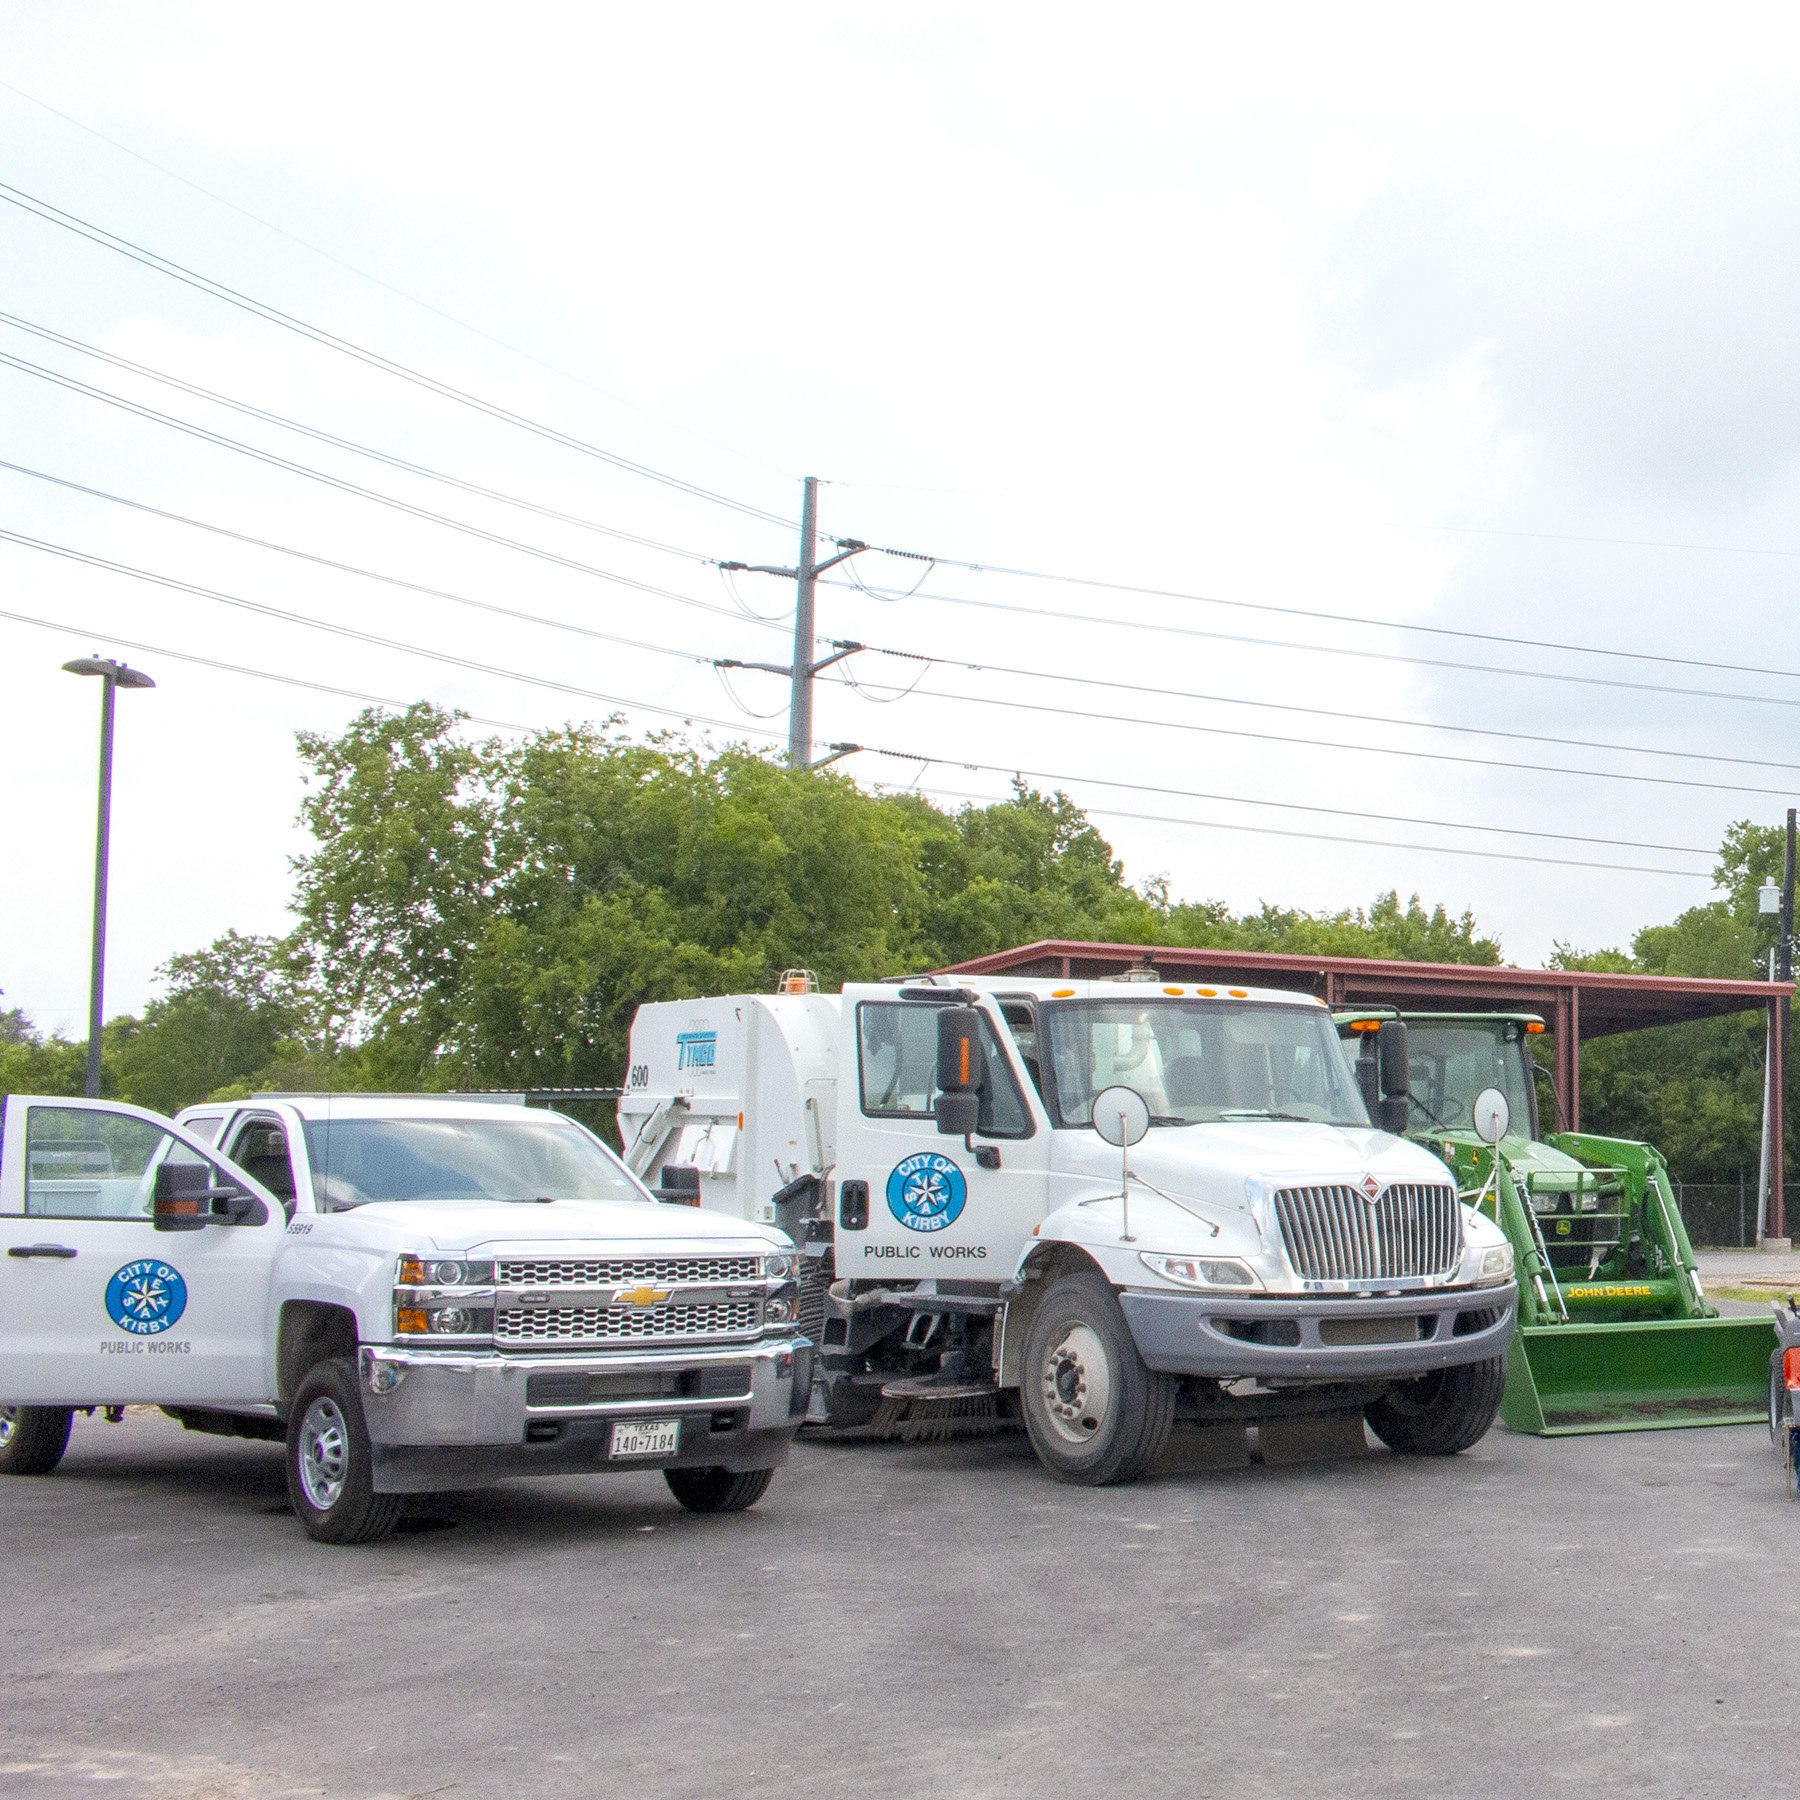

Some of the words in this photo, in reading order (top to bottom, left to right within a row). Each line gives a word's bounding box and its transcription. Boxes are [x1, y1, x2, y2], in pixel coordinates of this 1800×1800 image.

[631, 1065, 649, 1087] 600
[898, 1155, 931, 1176] CITY
[933, 1158, 956, 1174] OF
[904, 1173, 948, 1214] TEXAS
[902, 1210, 950, 1231] KIRBY
[864, 1246, 920, 1258] PUBLIC
[929, 1246, 987, 1258] WORKS
[118, 1263, 153, 1283] CITY
[157, 1266, 178, 1282] OF
[122, 1278, 169, 1319] TEXAS
[1568, 1287, 1604, 1297] JOHN
[1605, 1286, 1651, 1296] DEERE
[119, 1315, 170, 1333] KIRBY
[100, 1341, 144, 1354] PUBLIC
[147, 1341, 191, 1354] WORKS
